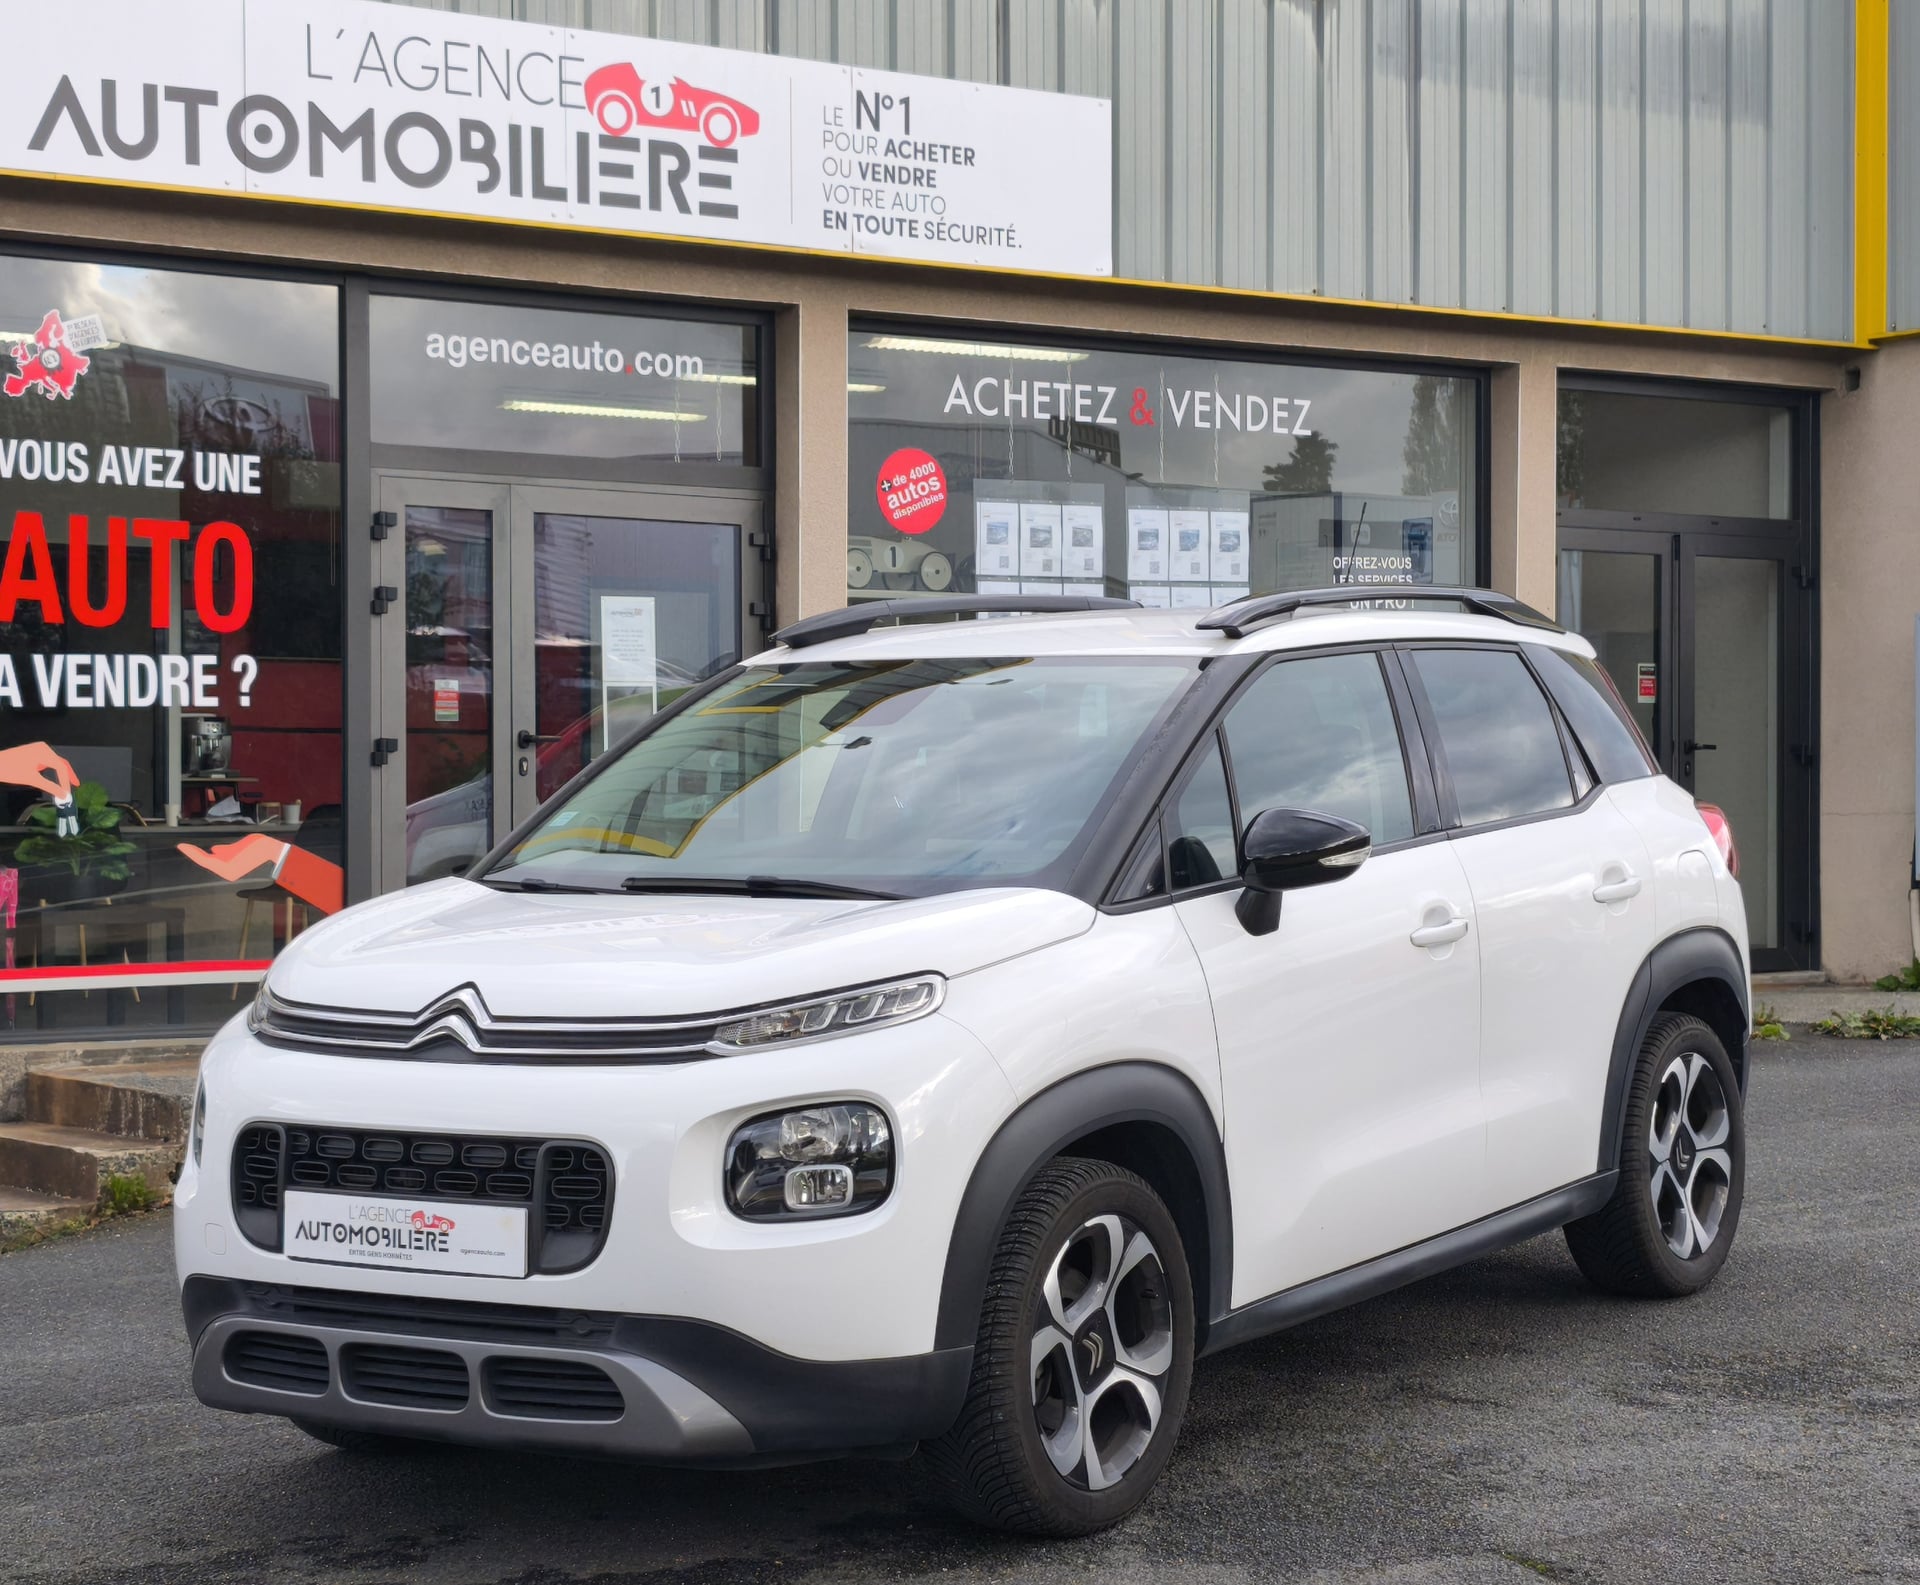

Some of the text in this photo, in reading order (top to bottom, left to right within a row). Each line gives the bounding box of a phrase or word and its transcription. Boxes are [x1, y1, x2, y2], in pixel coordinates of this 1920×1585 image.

[306, 23, 587, 110] L'AGENCE
[650, 86, 661, 109] 1
[823, 105, 844, 127] LE
[26, 74, 739, 220] AUTOMOBILIERE
[823, 130, 975, 167] POUR ACHETER
[822, 157, 937, 188] OU VENDRE
[822, 182, 946, 215] VOTRE AUTO
[823, 209, 1022, 249] EN TOUTE SÉCURITÉ.
[425, 333, 703, 378] agenceauto.com
[943, 373, 1312, 436] ACHETEZ & VENDEZ
[0, 438, 262, 494] VOUS AVEZ UNE
[893, 473, 907, 487] de
[910, 461, 936, 480] 4000
[887, 476, 941, 509] autos
[893, 492, 945, 520] disponibles
[0, 510, 253, 634] AUTO
[890, 546, 897, 568] 1
[1333, 556, 1413, 569] OFFREZ-VOUS
[31, 654, 219, 708] VENDRE
[231, 655, 258, 708] ?
[348, 1204, 412, 1225] L'AGENCE
[295, 1219, 449, 1253] AUTOMOBILIERE
